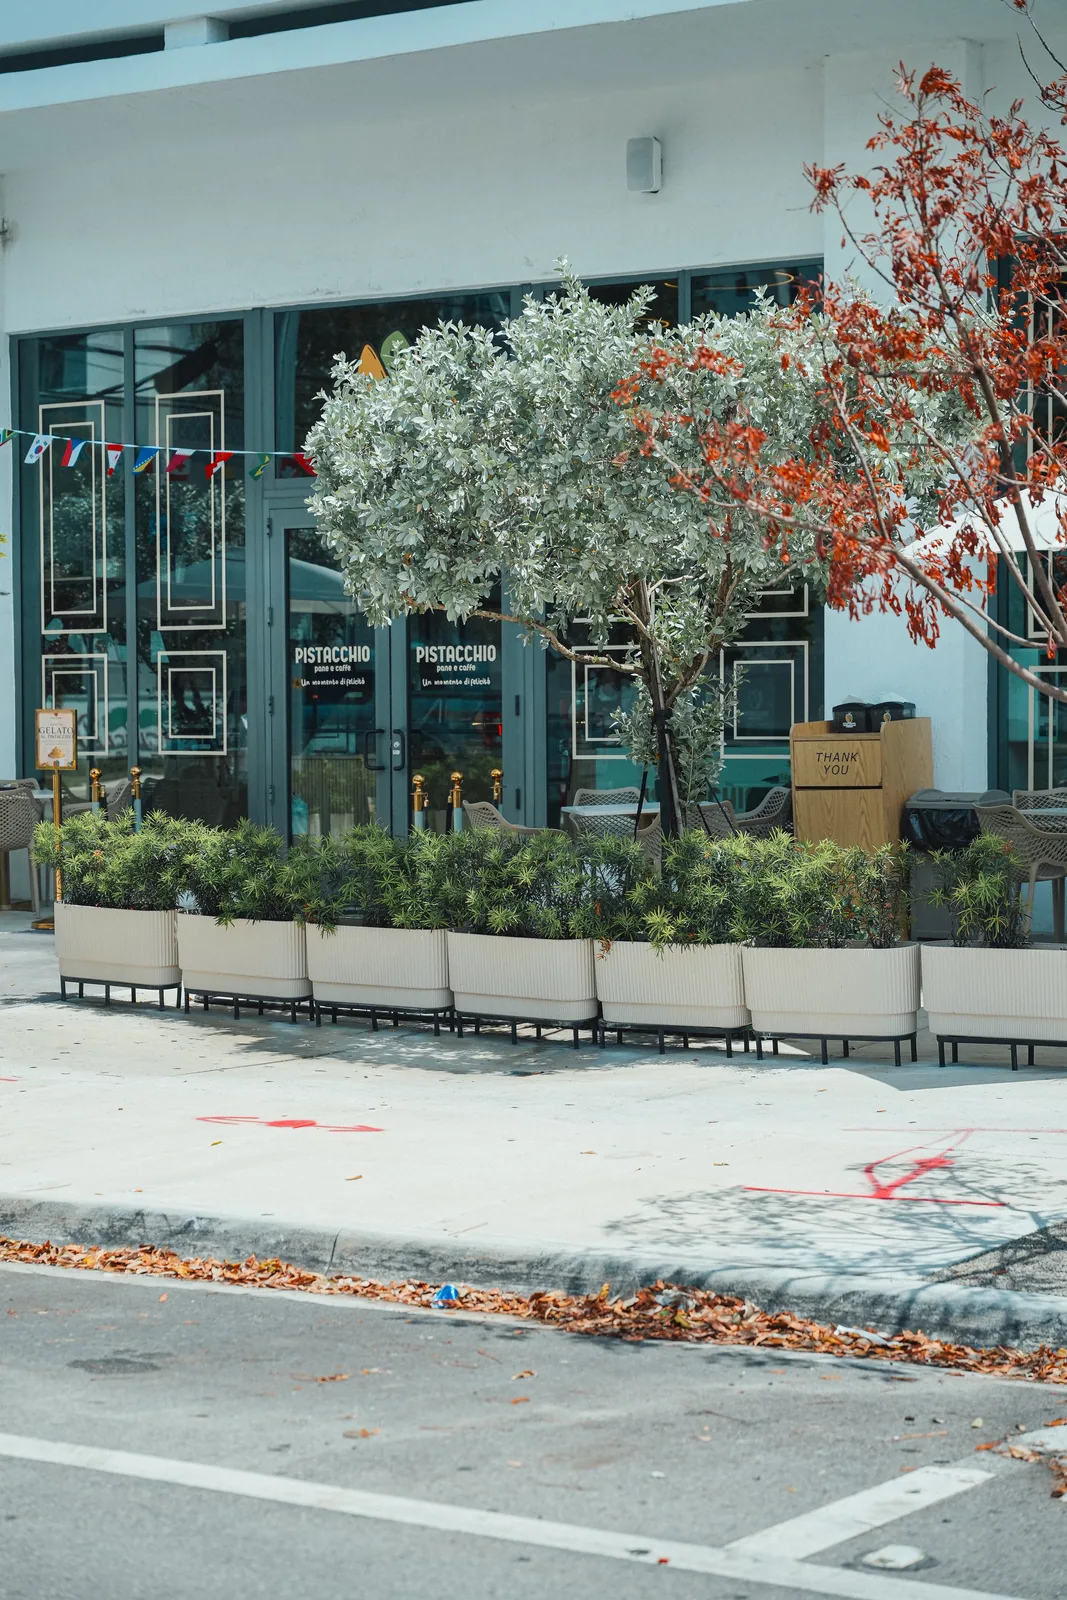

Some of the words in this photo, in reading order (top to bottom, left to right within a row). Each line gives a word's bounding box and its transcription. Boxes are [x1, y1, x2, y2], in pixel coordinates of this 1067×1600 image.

[295, 645, 371, 664] PISTACCHIO
[416, 644, 497, 663] PISTACCHIO
[314, 665, 330, 674] pane
[436, 665, 453, 673] pane
[300, 678, 310, 687] Un
[312, 678, 339, 686] momento
[339, 677, 346, 686] di
[422, 678, 432, 687] Un
[433, 678, 463, 686] momento
[463, 677, 470, 686] di
[38, 726, 74, 734] GELATO
[816, 752, 859, 763] THANK
[823, 764, 850, 776] YOU
